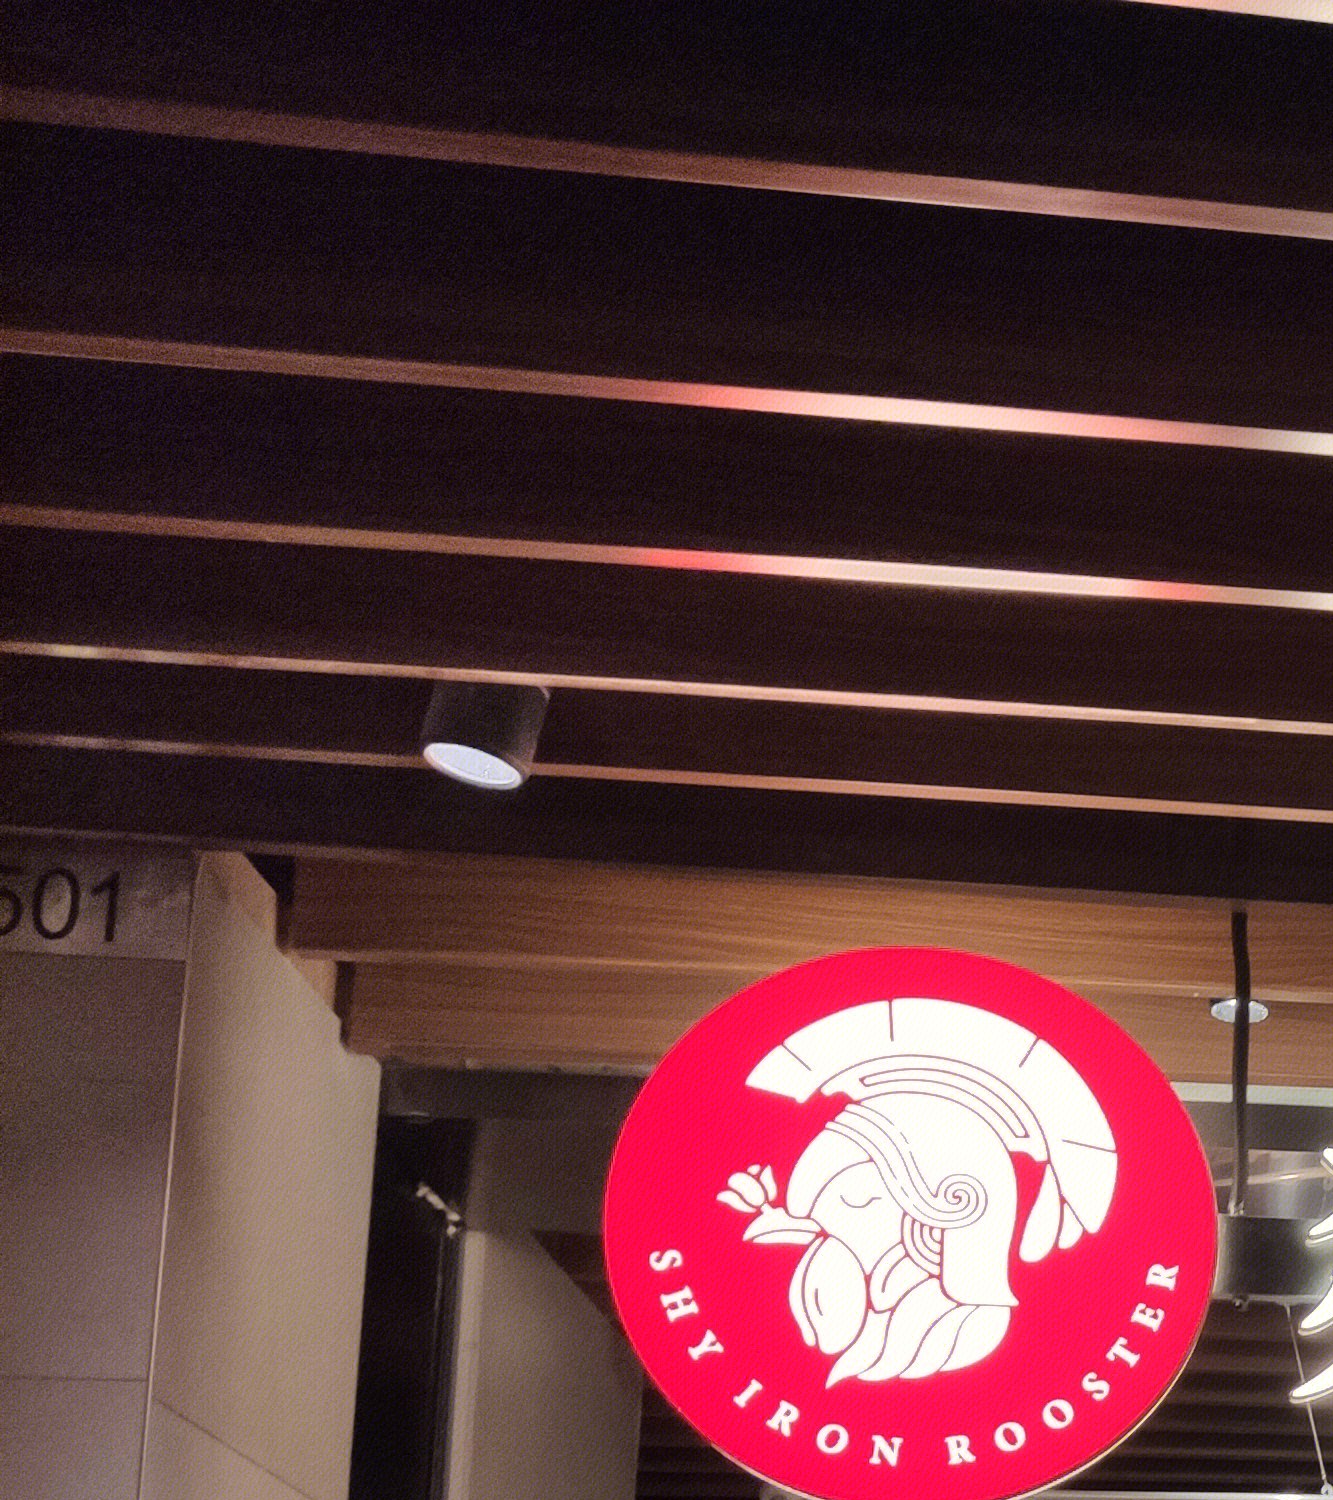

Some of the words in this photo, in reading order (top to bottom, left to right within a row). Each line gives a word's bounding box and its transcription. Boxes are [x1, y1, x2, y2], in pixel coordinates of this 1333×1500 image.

[648, 1248, 725, 1361] SHY
[733, 1378, 901, 1467] IRON
[944, 1262, 1180, 1466] ROOSTER
